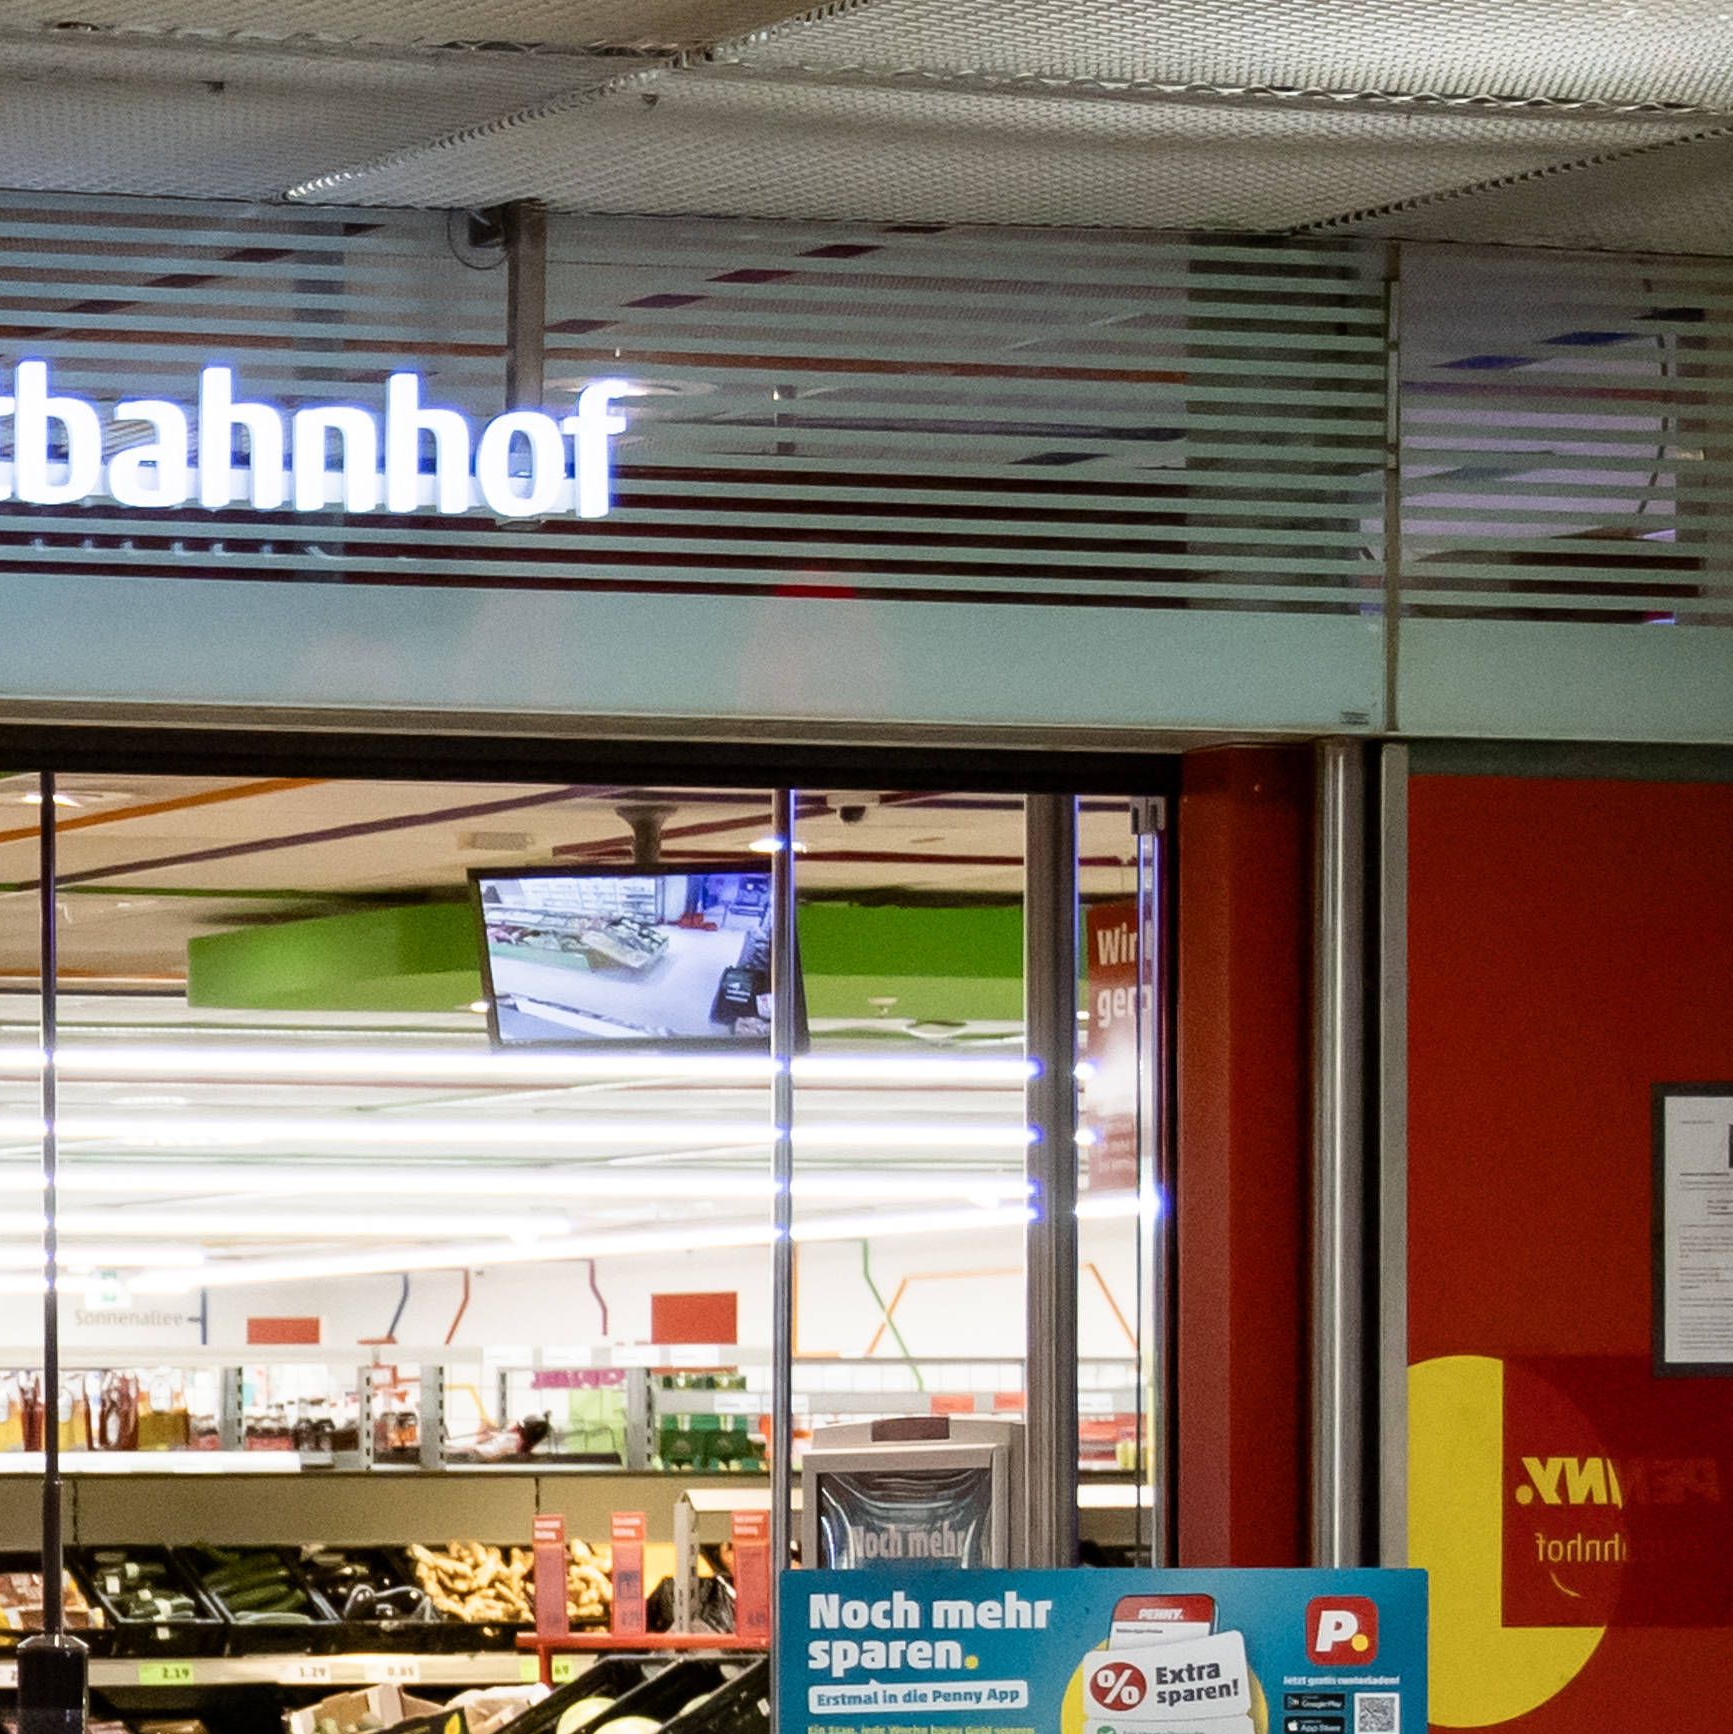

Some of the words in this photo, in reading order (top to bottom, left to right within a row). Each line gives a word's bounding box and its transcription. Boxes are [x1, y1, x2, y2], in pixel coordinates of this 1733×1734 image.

[852, 1522, 902, 1559] Noch
[907, 1520, 967, 1558] mehr
[808, 1591, 921, 1629] Noch
[932, 1591, 1052, 1629] mehr
[162, 1666, 190, 1679] 2.19
[808, 1638, 979, 1678] sparen.
[1156, 1662, 1221, 1686] Extra
[817, 1690, 878, 1707] Erstmal
[883, 1690, 898, 1704] in
[902, 1689, 928, 1703] die
[932, 1690, 983, 1705] Penny
[987, 1688, 1020, 1703] App
[1156, 1678, 1240, 1708] sparen!
